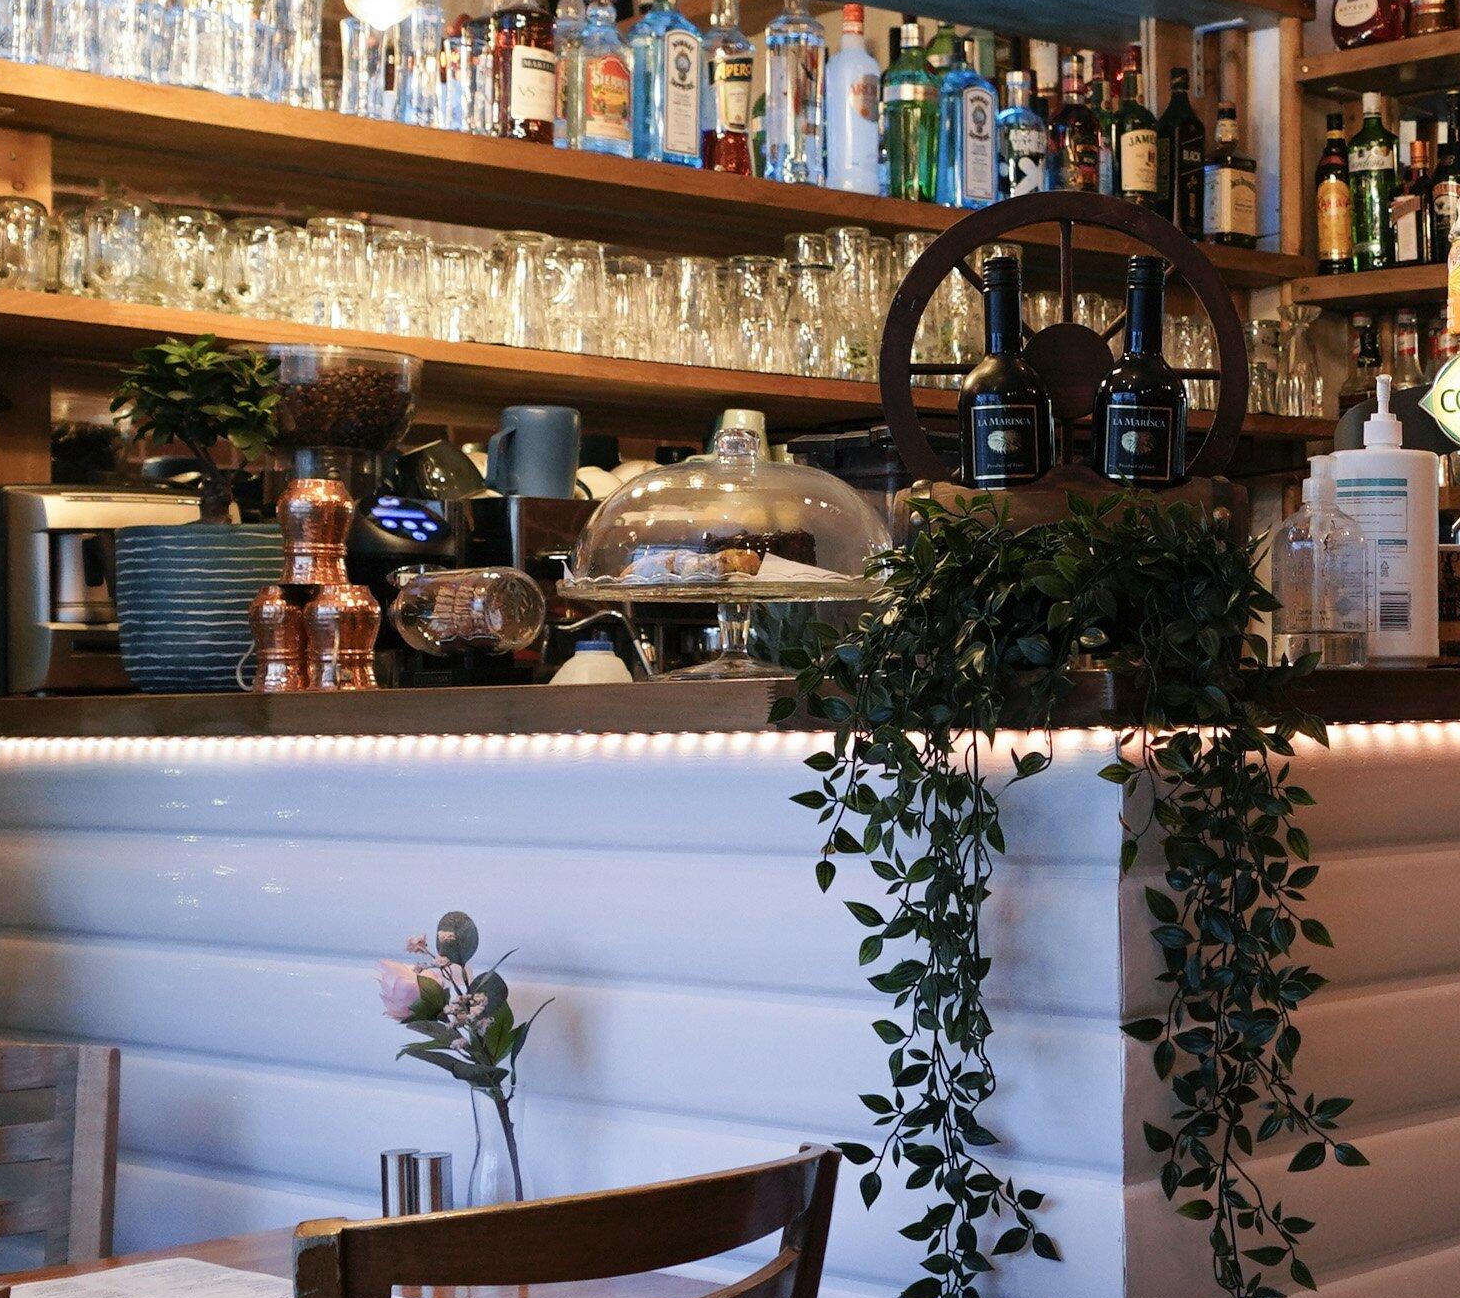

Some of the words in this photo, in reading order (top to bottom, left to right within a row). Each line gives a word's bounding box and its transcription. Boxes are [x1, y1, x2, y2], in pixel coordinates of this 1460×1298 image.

[977, 418, 988, 427] LA
[990, 417, 1032, 427] MARESCA
[1112, 418, 1123, 427] LA
[1125, 417, 1167, 428] MARESCA
